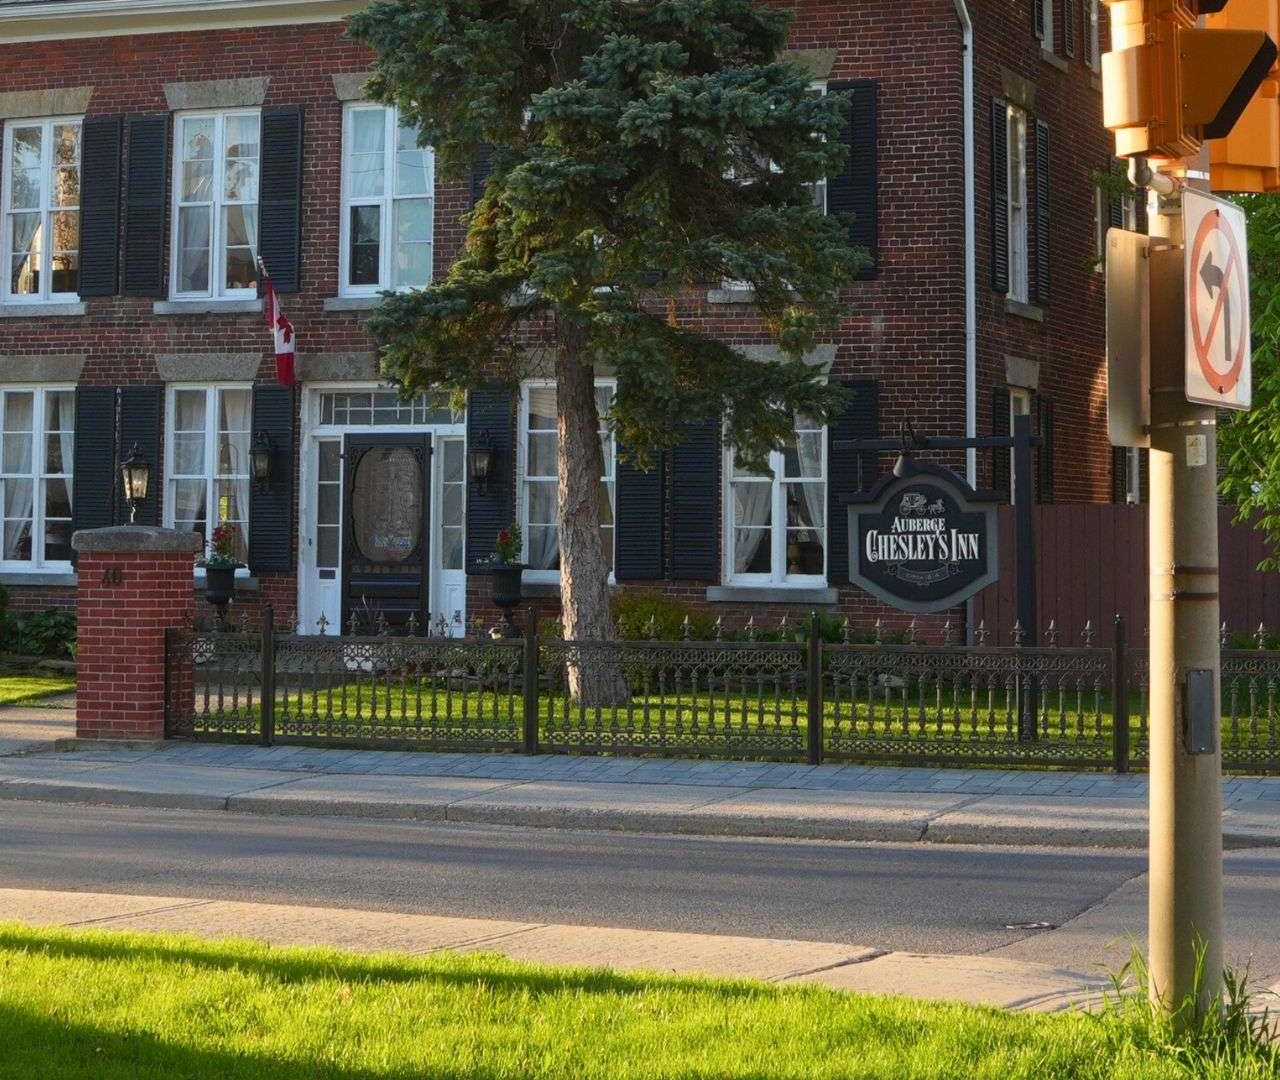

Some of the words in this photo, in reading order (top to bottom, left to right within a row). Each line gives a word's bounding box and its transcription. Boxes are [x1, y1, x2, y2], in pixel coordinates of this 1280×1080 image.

[891, 517, 945, 533] AUBERGE
[866, 529, 949, 562] CHESLEY'S
[951, 528, 980, 561] INN
